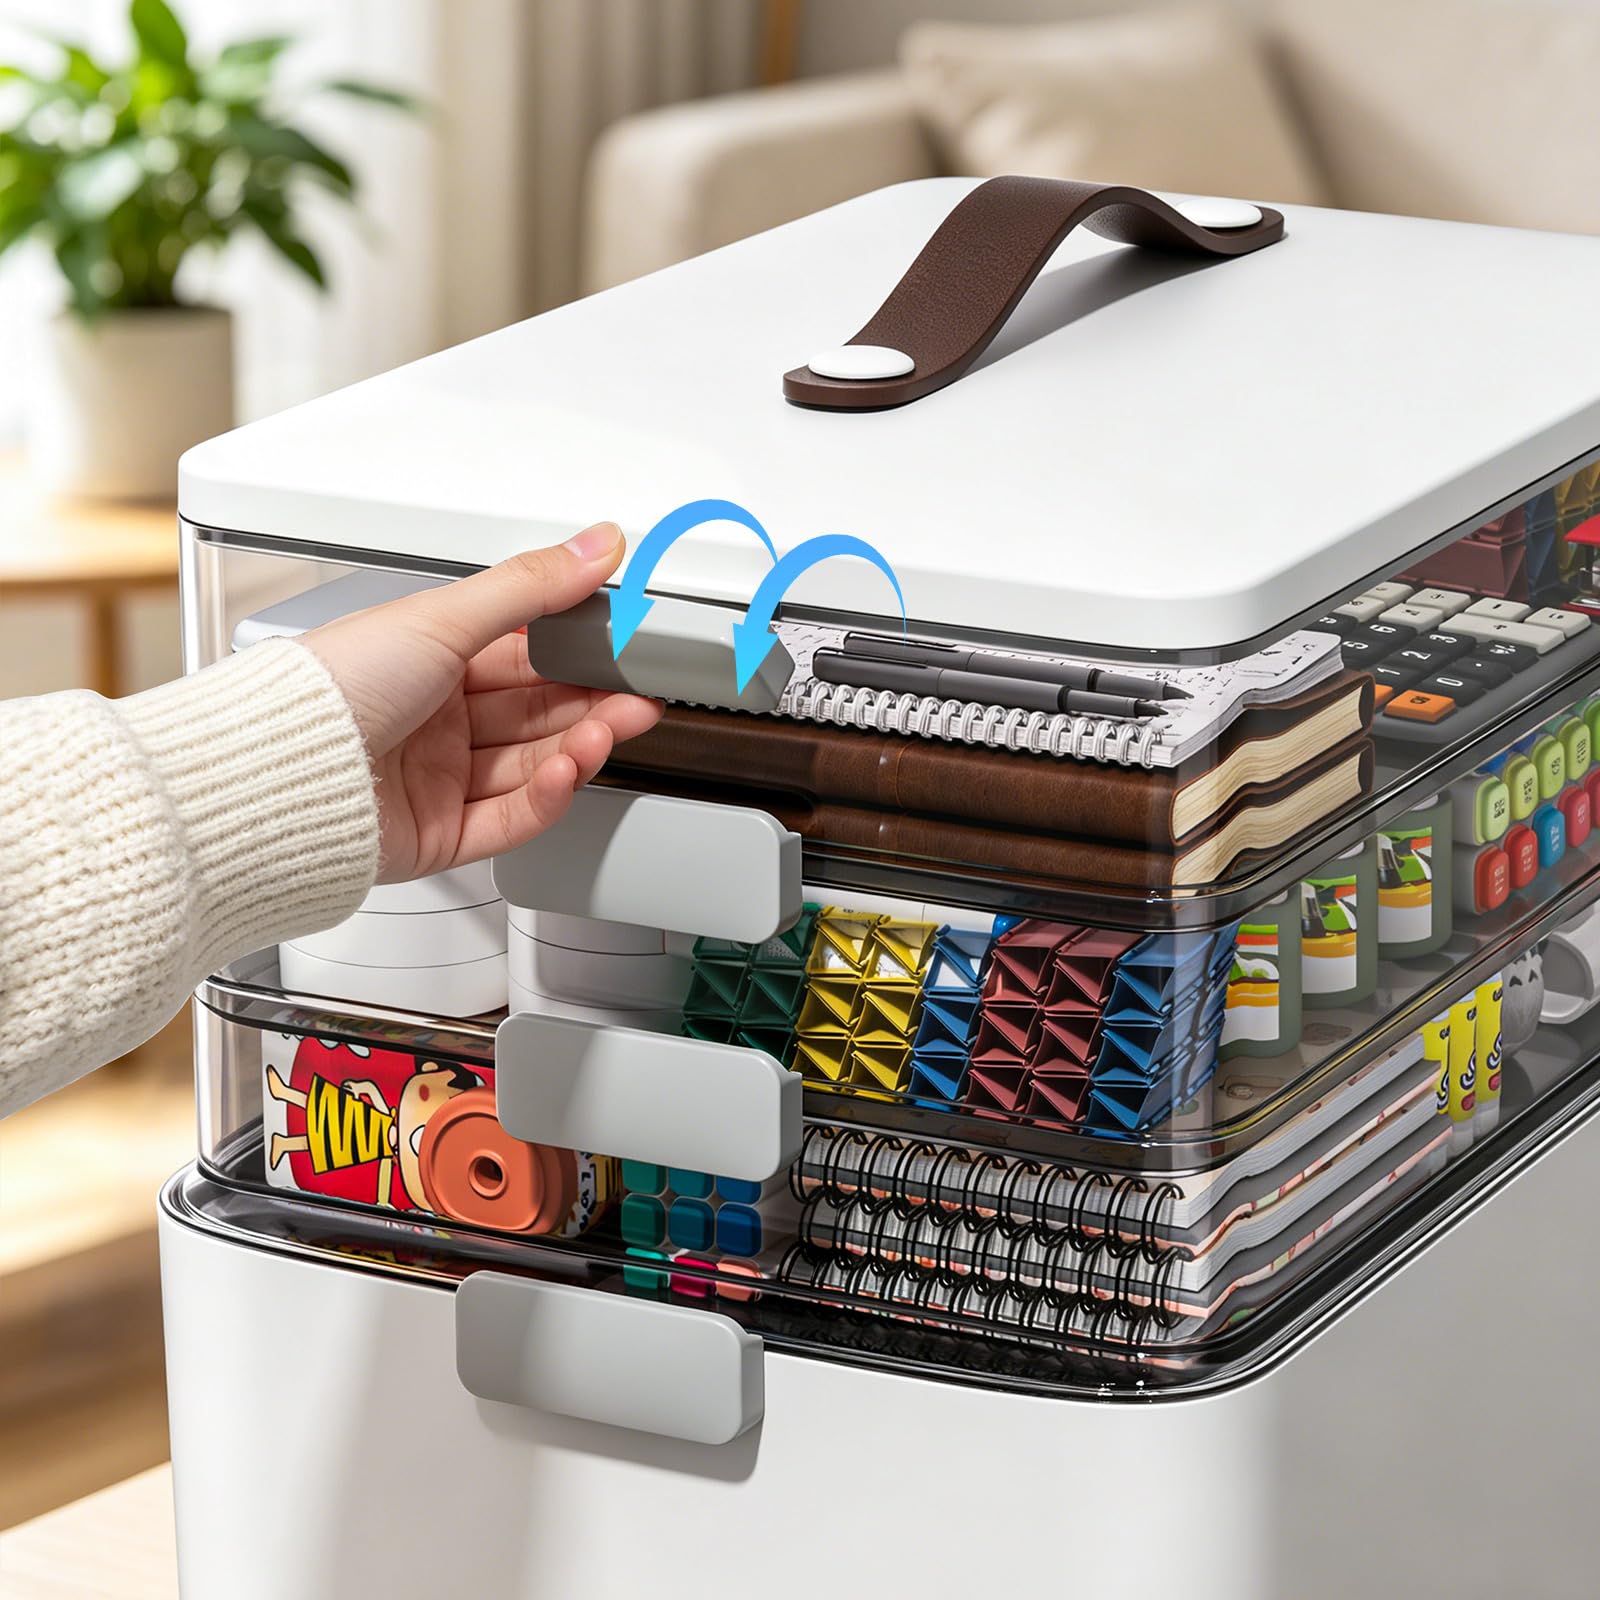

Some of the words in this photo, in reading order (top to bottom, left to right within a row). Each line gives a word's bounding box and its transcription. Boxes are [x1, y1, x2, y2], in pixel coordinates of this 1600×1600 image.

[1369, 624, 1396, 633] 6
[1429, 634, 1457, 643] 3
[1401, 650, 1431, 660] 2
[1377, 667, 1400, 676] 1
[1436, 677, 1463, 687] 0
